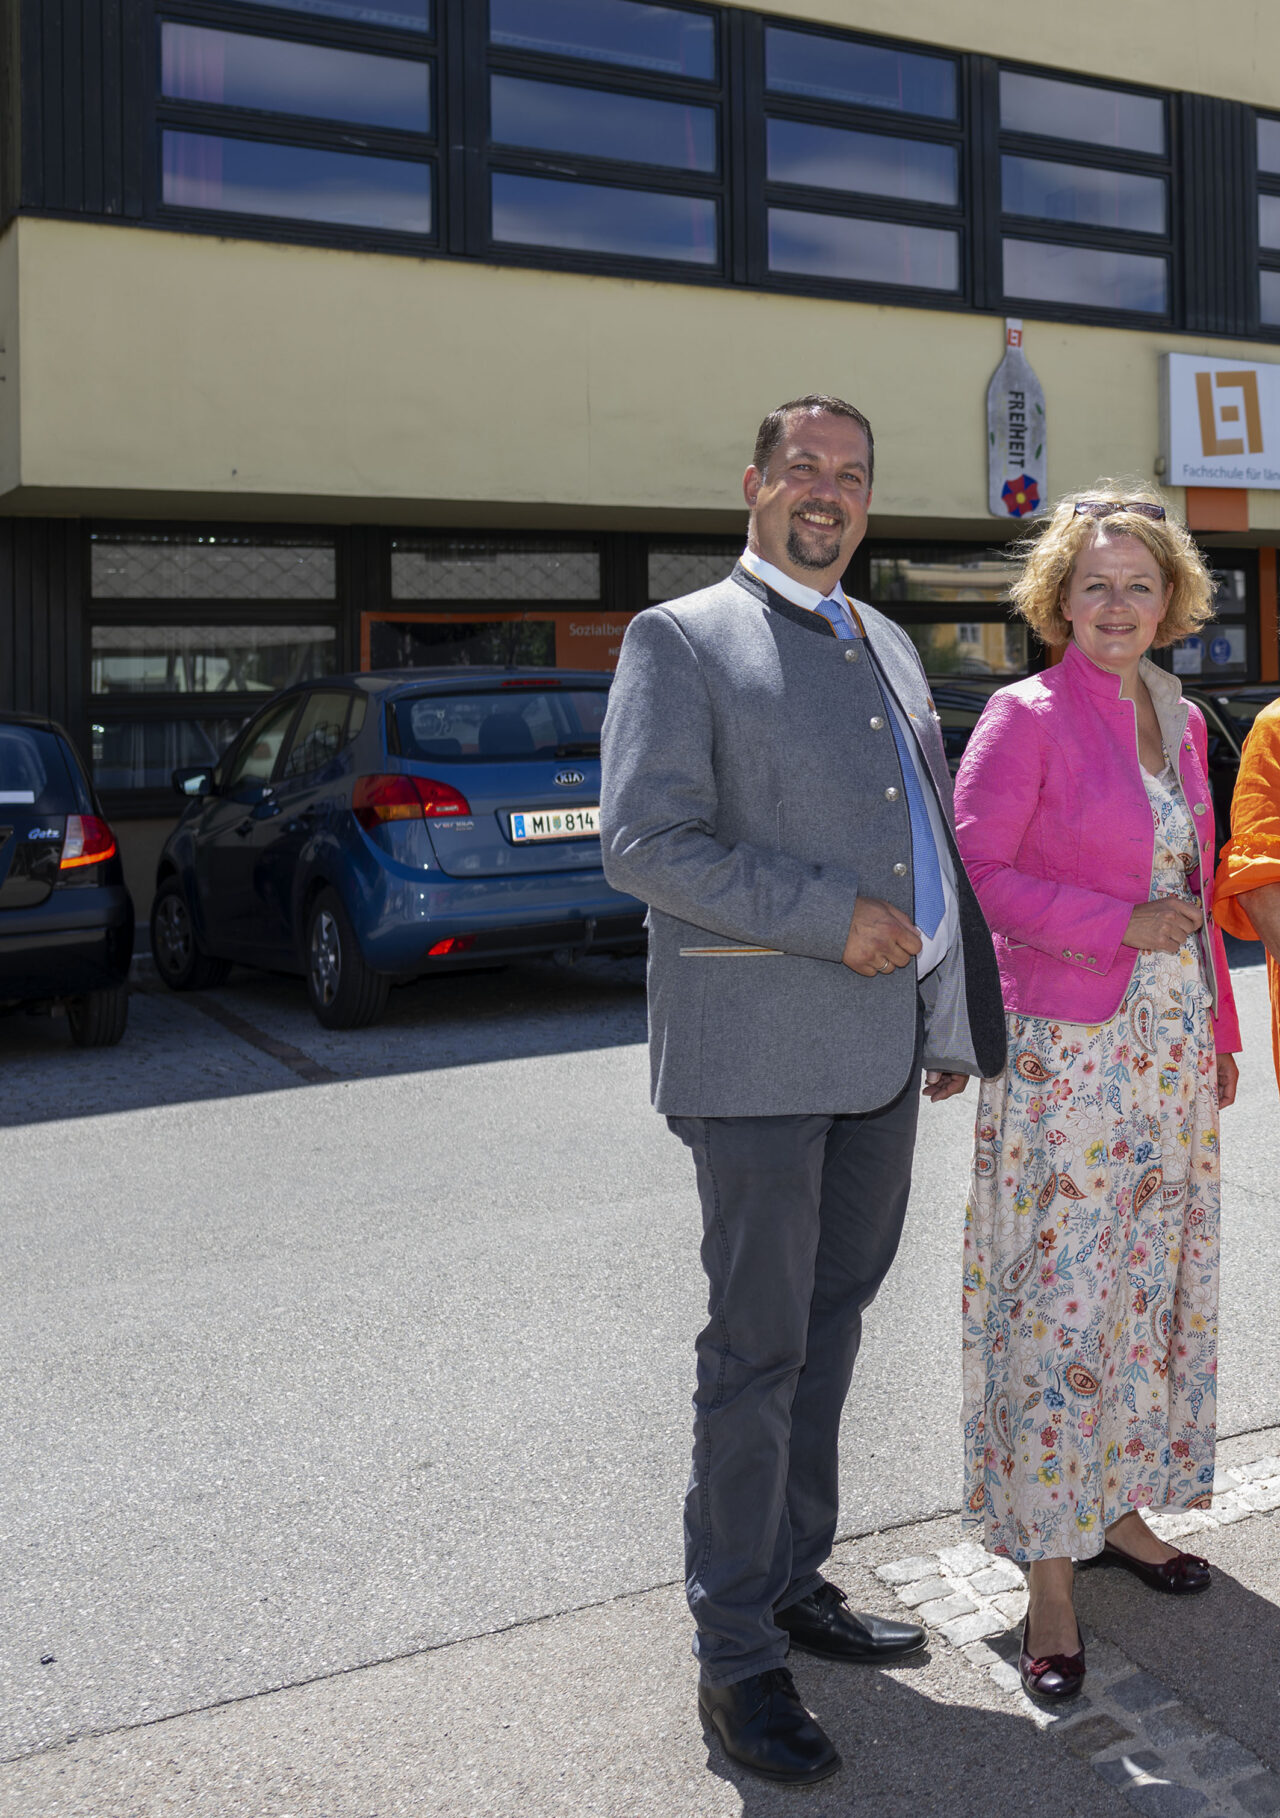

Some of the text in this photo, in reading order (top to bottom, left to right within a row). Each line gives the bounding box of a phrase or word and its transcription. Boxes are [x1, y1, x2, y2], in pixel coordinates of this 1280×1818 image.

[1008, 390, 1026, 468] FREIHEIT
[1182, 464, 1244, 480] Fachschule
[1245, 467, 1262, 481] für
[560, 770, 581, 783] KIA
[531, 816, 551, 834] MI
[565, 811, 594, 832] 814
